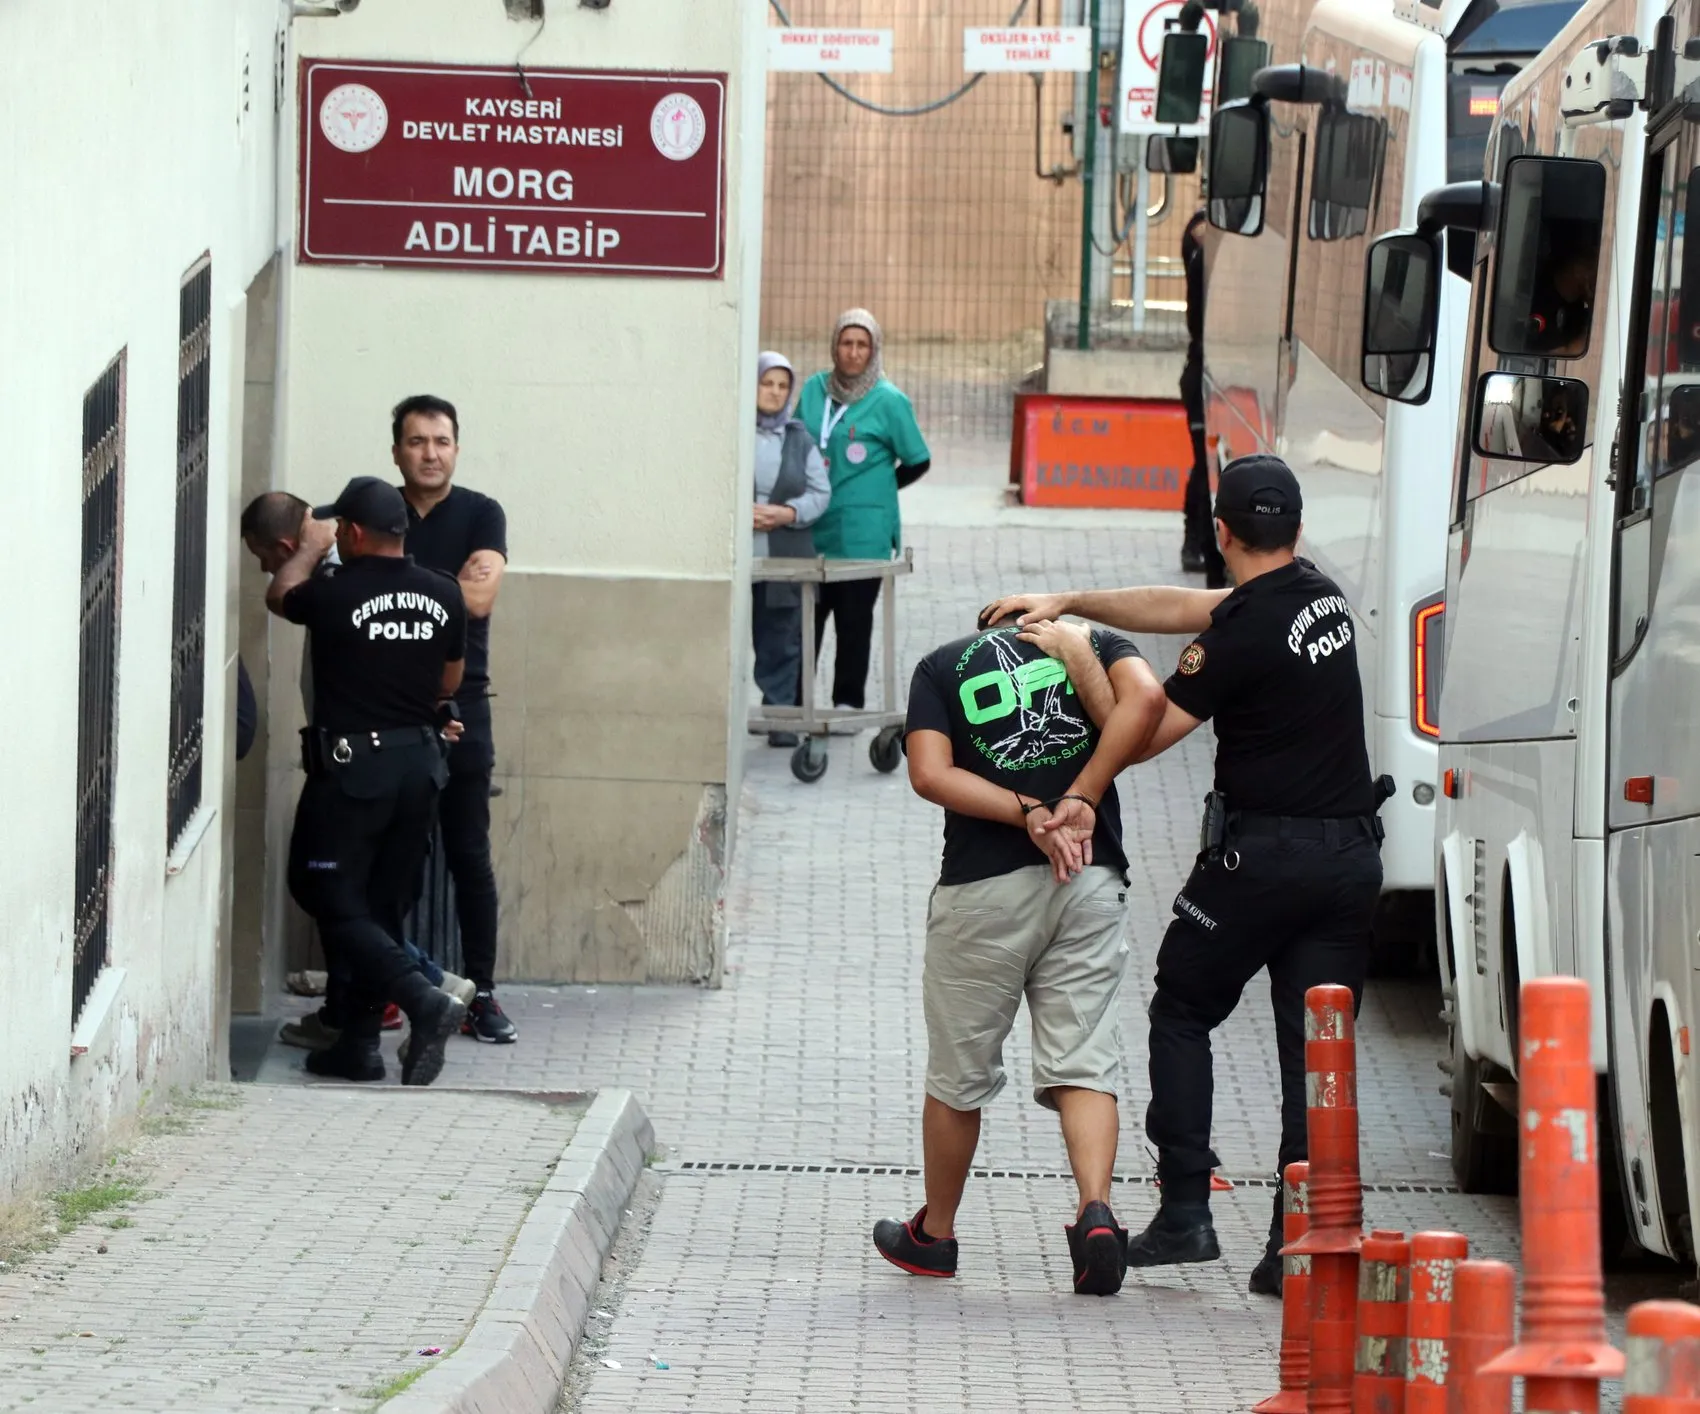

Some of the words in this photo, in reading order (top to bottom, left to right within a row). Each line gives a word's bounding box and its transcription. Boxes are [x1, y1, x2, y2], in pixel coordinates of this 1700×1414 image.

[465, 97, 562, 120] KAYSERİ
[402, 121, 491, 143] DEVLET
[496, 124, 624, 148] HASTANESİ
[452, 166, 574, 201] MORG
[404, 216, 496, 254] ADLİ
[505, 219, 620, 258] TABİP
[396, 591, 449, 627] KUVVET
